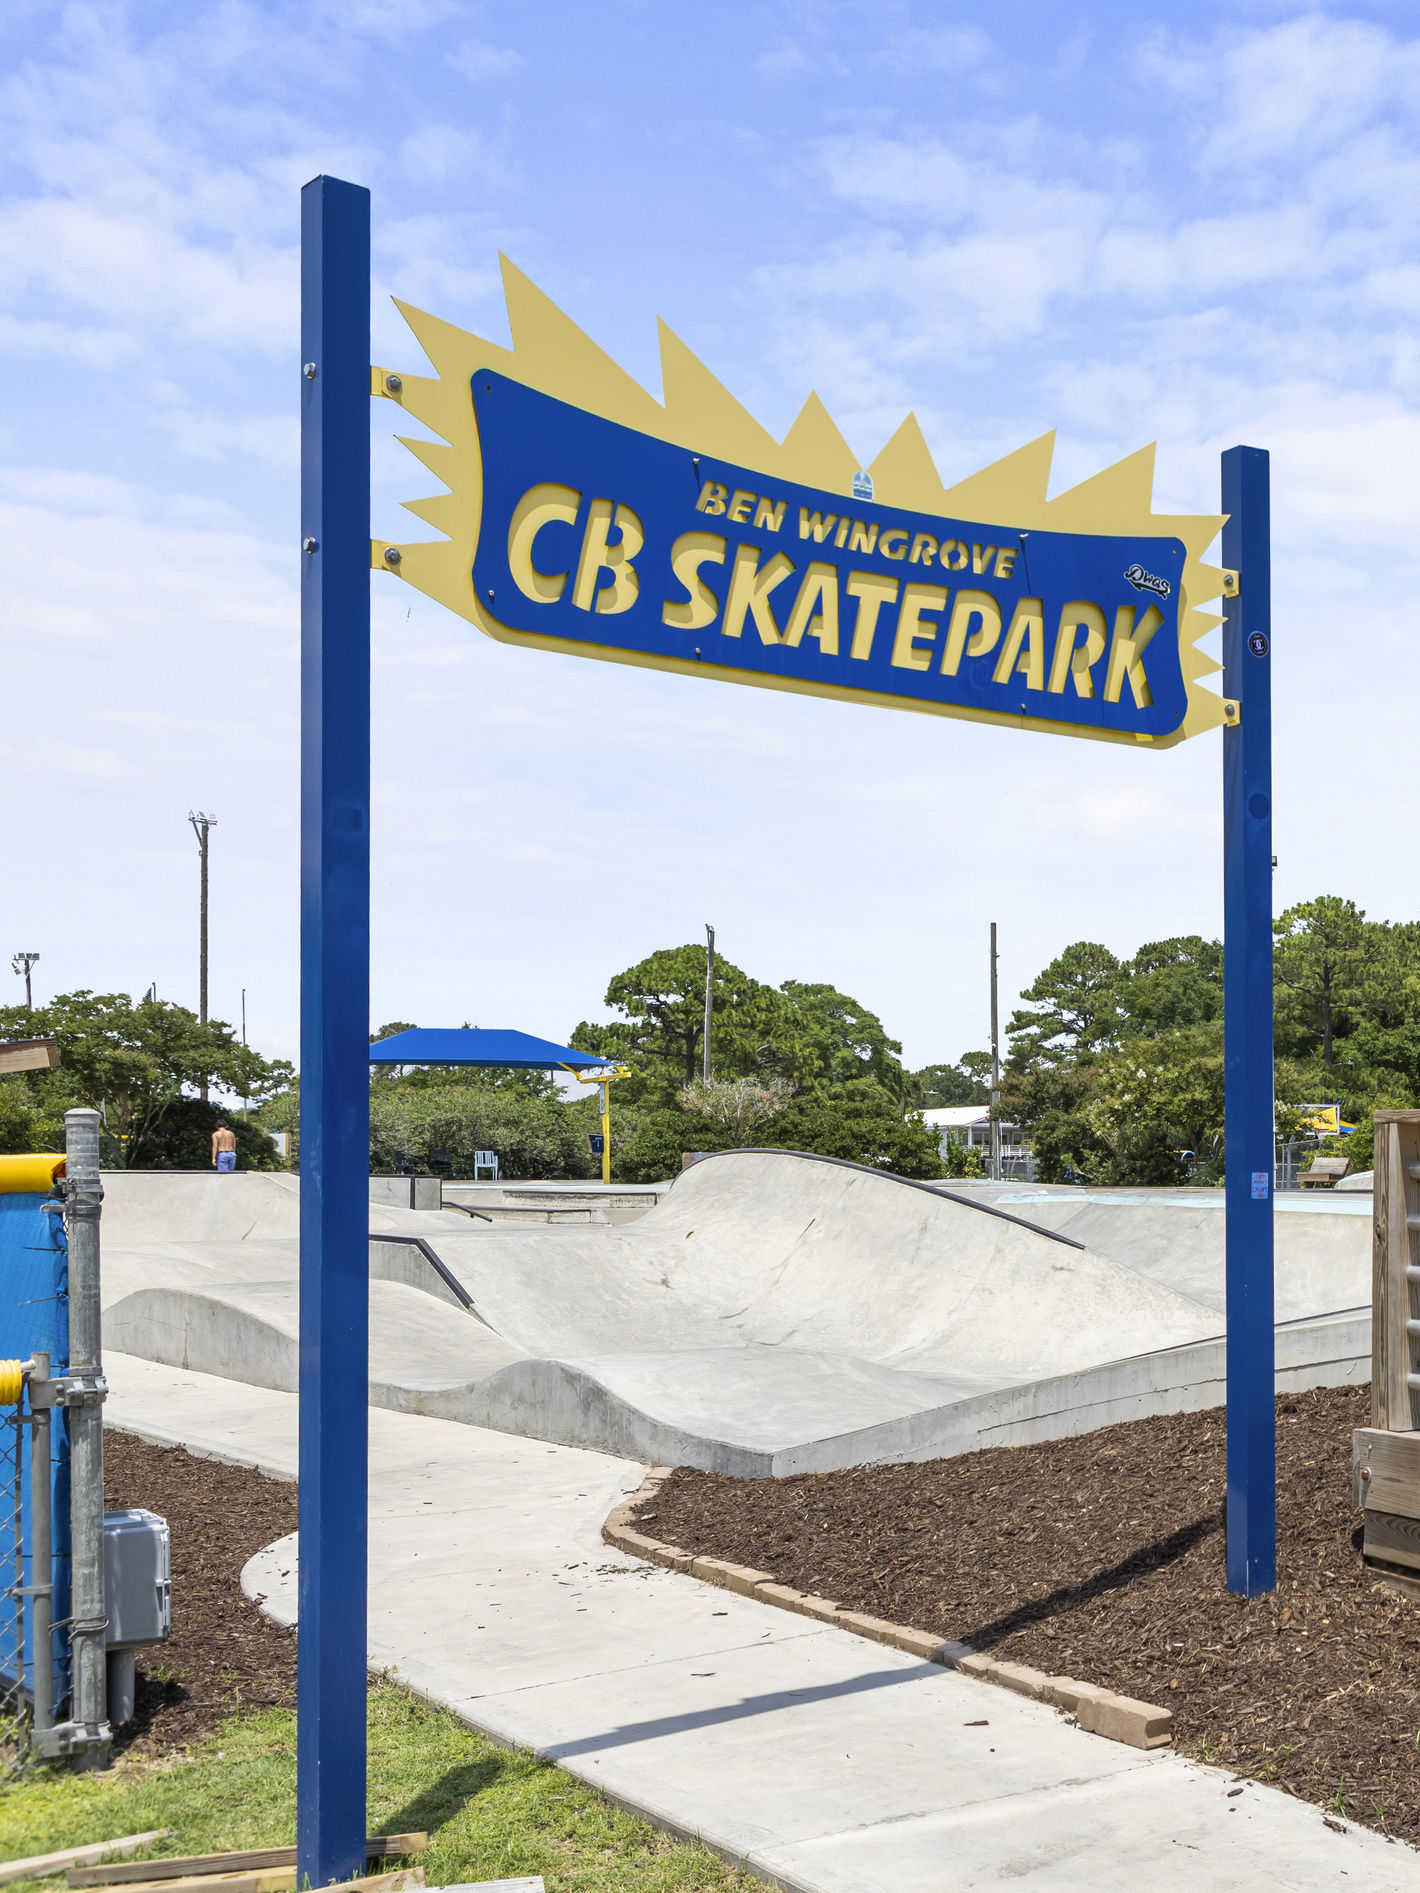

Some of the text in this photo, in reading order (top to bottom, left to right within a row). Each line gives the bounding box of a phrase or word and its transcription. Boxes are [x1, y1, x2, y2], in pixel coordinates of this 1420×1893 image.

[507, 482, 1165, 709] CB SKATEPARK
[695, 480, 1019, 578] BEN WINGROVE
